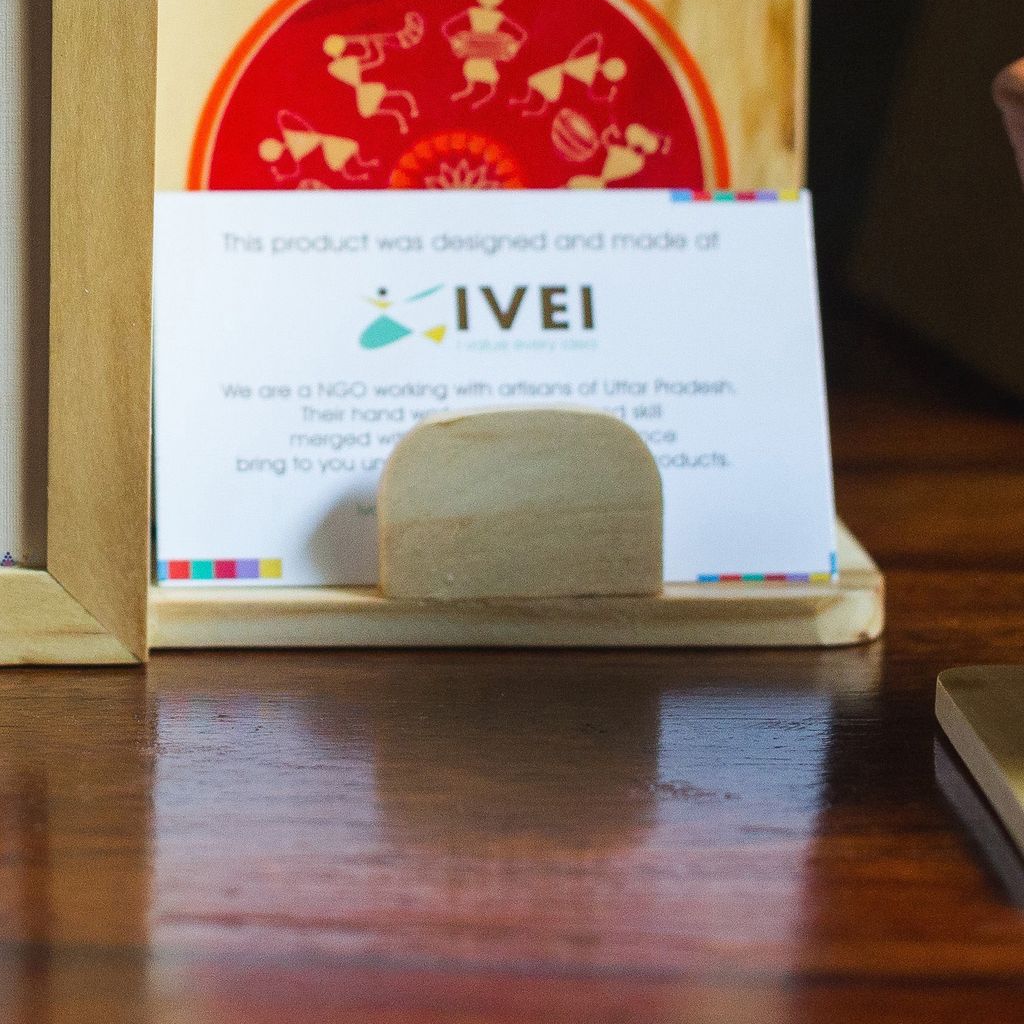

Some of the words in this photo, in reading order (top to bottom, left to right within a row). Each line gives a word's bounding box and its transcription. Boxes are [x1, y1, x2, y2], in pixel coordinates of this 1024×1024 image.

[222, 232, 264, 253] This
[271, 232, 370, 256] product
[375, 236, 425, 253] was
[431, 231, 549, 257] designed
[555, 231, 606, 252] and
[611, 230, 690, 252] made
[694, 230, 720, 252] at
[455, 283, 595, 331] IVEI
[222, 383, 253, 398] We
[258, 385, 292, 399] are
[297, 384, 313, 398] a
[318, 381, 368, 398] NGO
[374, 381, 449, 400] working
[454, 381, 493, 397] with
[497, 380, 573, 397] artisans
[577, 379, 598, 396] of
[302, 405, 344, 422] Their
[351, 405, 404, 422] hand
[289, 431, 371, 451] merged
[235, 457, 288, 476] bring
[292, 456, 313, 473] to
[318, 458, 355, 474] you
[655, 450, 732, 470] oducts.
